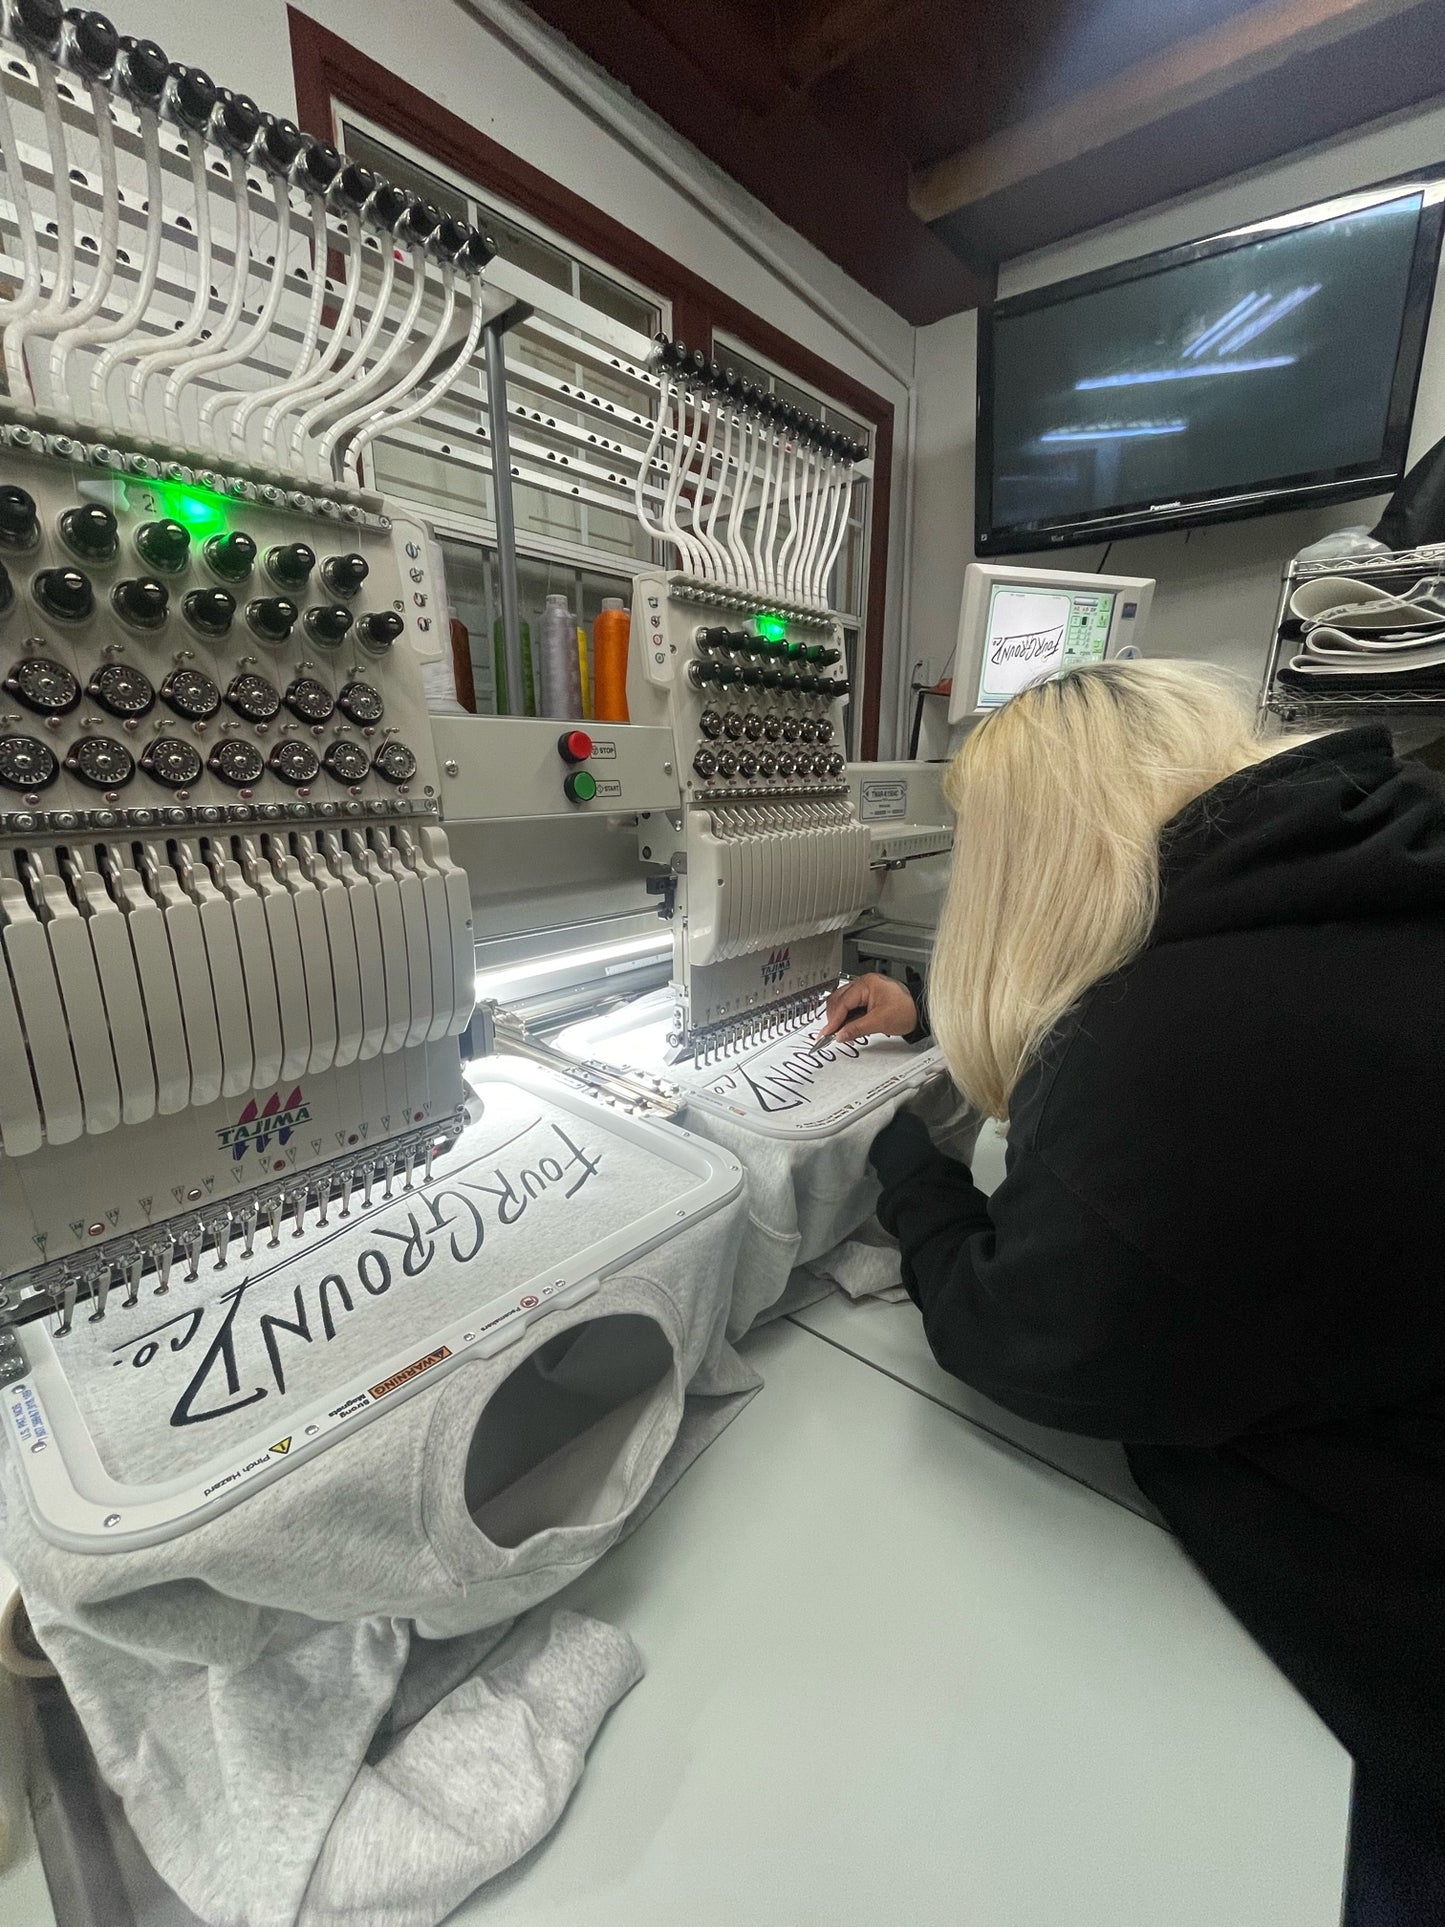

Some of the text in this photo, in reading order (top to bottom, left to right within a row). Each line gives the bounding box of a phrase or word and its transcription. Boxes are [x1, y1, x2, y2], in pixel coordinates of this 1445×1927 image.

[142, 493, 157, 513] 2
[761, 960, 790, 975] TAJIMA
[218, 1106, 310, 1145] TAJIMA
[480, 1307, 521, 1332] Pacemakers
[374, 1357, 436, 1395] WARNING
[328, 1394, 366, 1417] Magnets
[339, 1399, 370, 1418] Strong
[203, 1454, 270, 1496] Pinch Hazard
